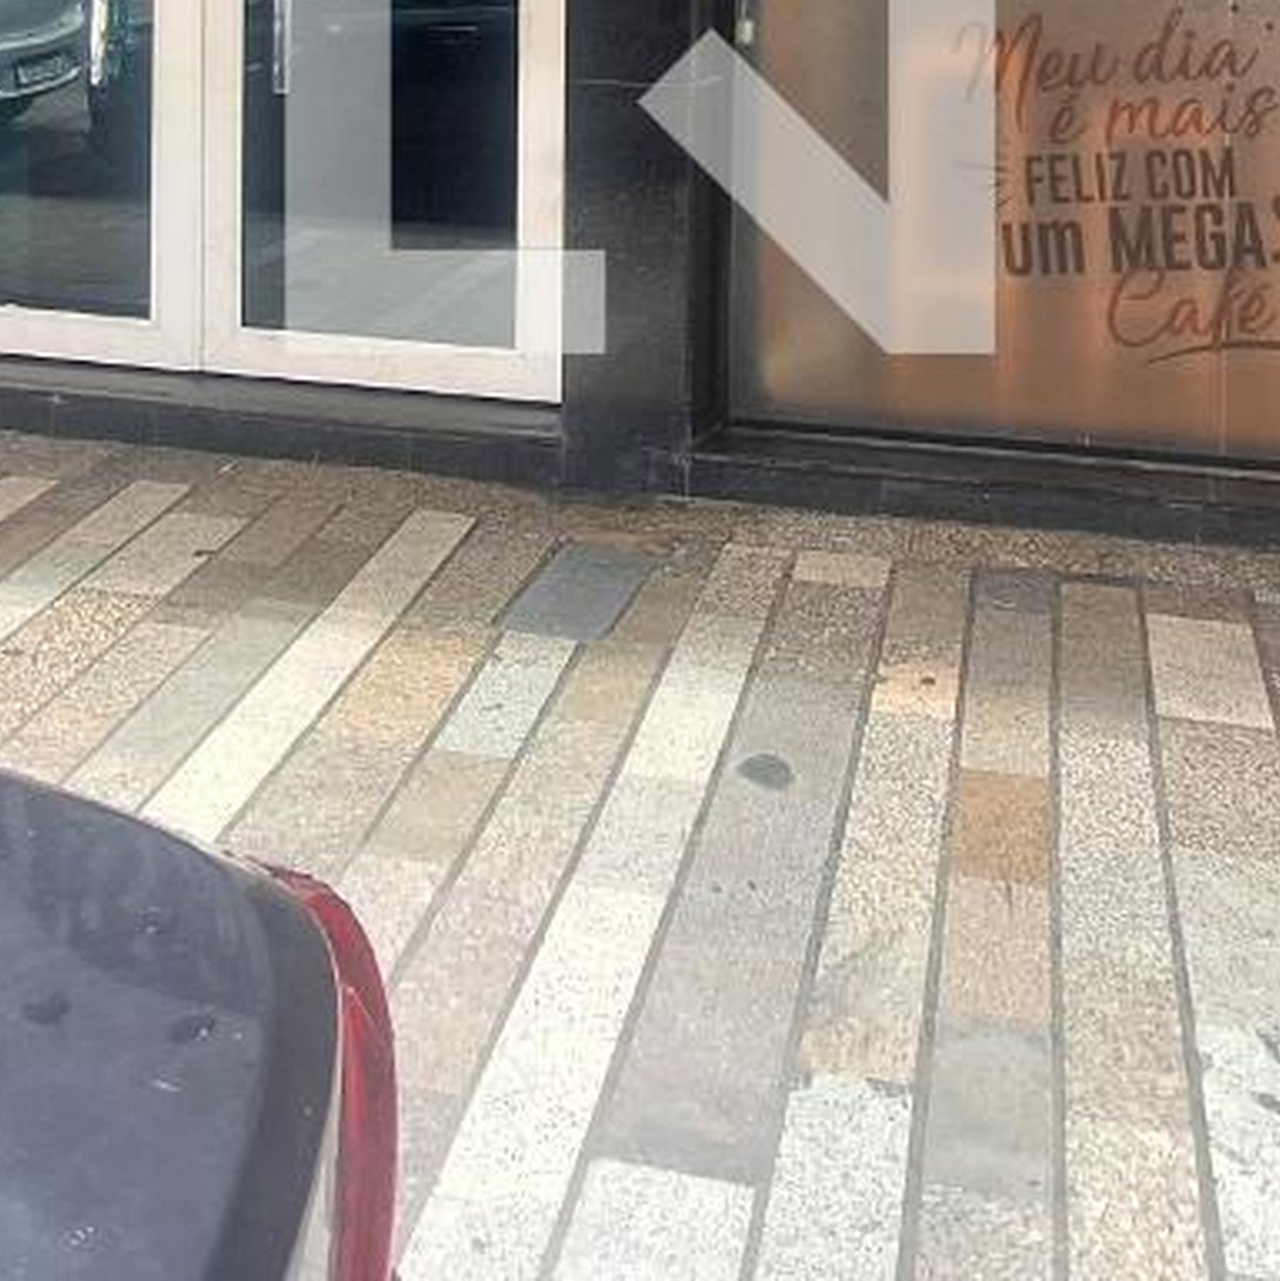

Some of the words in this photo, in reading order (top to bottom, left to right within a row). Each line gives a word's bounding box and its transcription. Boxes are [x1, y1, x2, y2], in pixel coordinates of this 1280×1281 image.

[1133, 8, 1260, 85] dia
[1106, 82, 1279, 147] mais
[1023, 151, 1131, 206] FELIZ
[1145, 146, 1236, 200] COM
[1109, 201, 1267, 273] MEGA
[1107, 269, 1277, 348] Café
